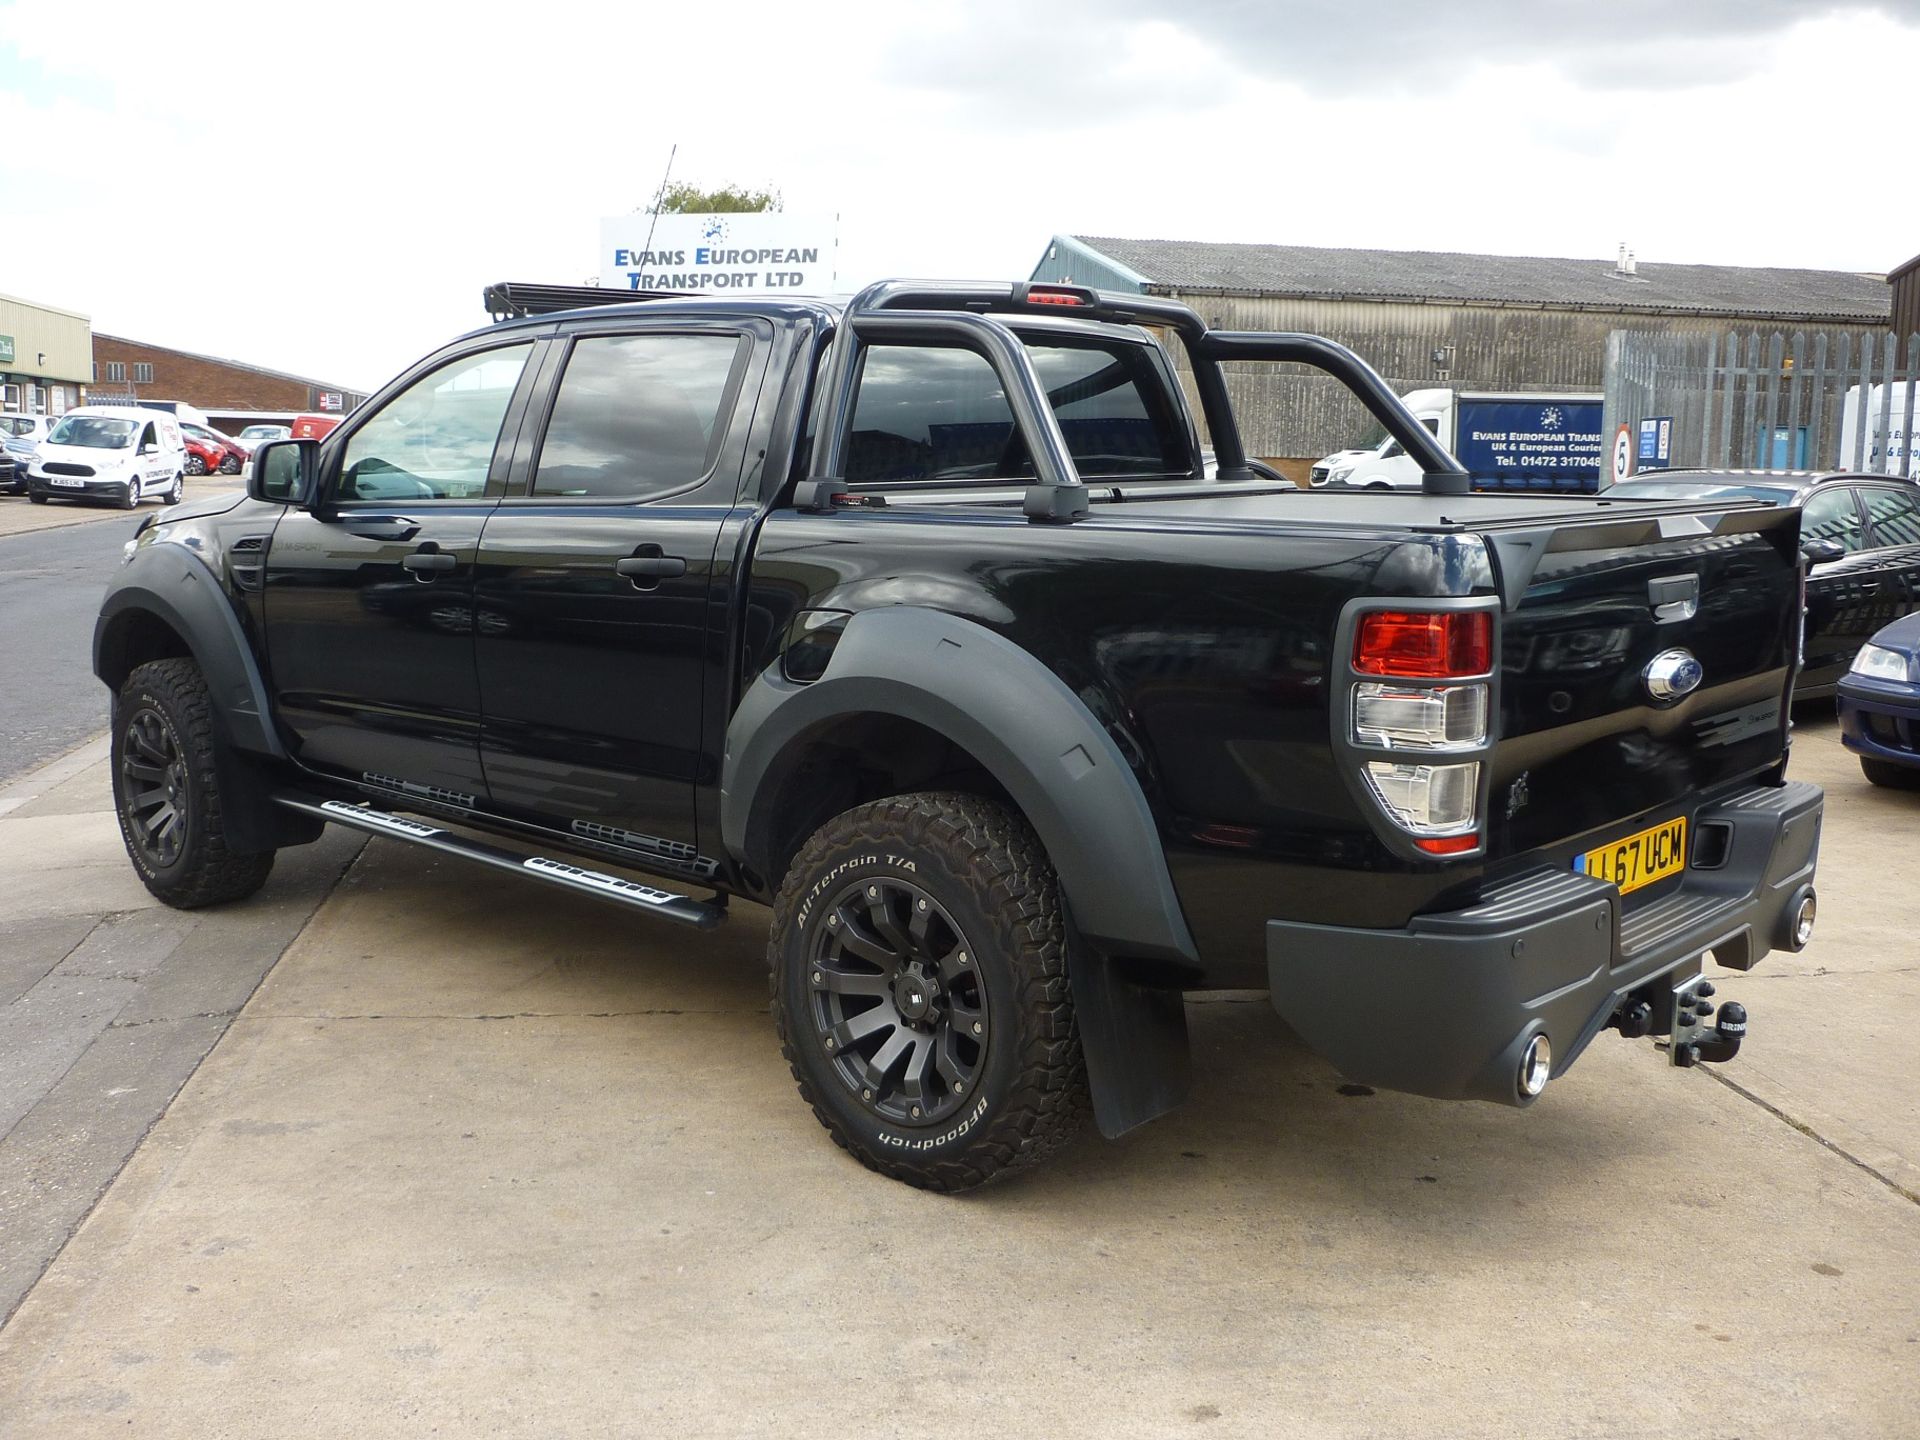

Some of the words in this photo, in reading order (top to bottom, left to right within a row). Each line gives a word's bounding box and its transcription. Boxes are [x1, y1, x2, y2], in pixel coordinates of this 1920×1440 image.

[614, 249, 685, 267] EVANS
[695, 247, 818, 265] EUROPEAN
[627, 272, 757, 290] TRANSPORT
[765, 272, 804, 288] LTD
[1472, 431, 1506, 441] EVANS
[1509, 432, 1565, 442] EUROPEAN
[1491, 443, 1507, 451] UK
[1509, 443, 1517, 451] &
[1519, 443, 1566, 453] European
[1495, 456, 1517, 466] Tel.
[1521, 456, 1557, 467] 01472
[1560, 456, 1601, 467] 317048
[1618, 442, 1626, 475] 5
[1645, 824, 1683, 875] UCM
[797, 855, 877, 930] All-Terrain
[886, 854, 917, 873] T/A
[878, 1096, 988, 1151] BFGoodrich
